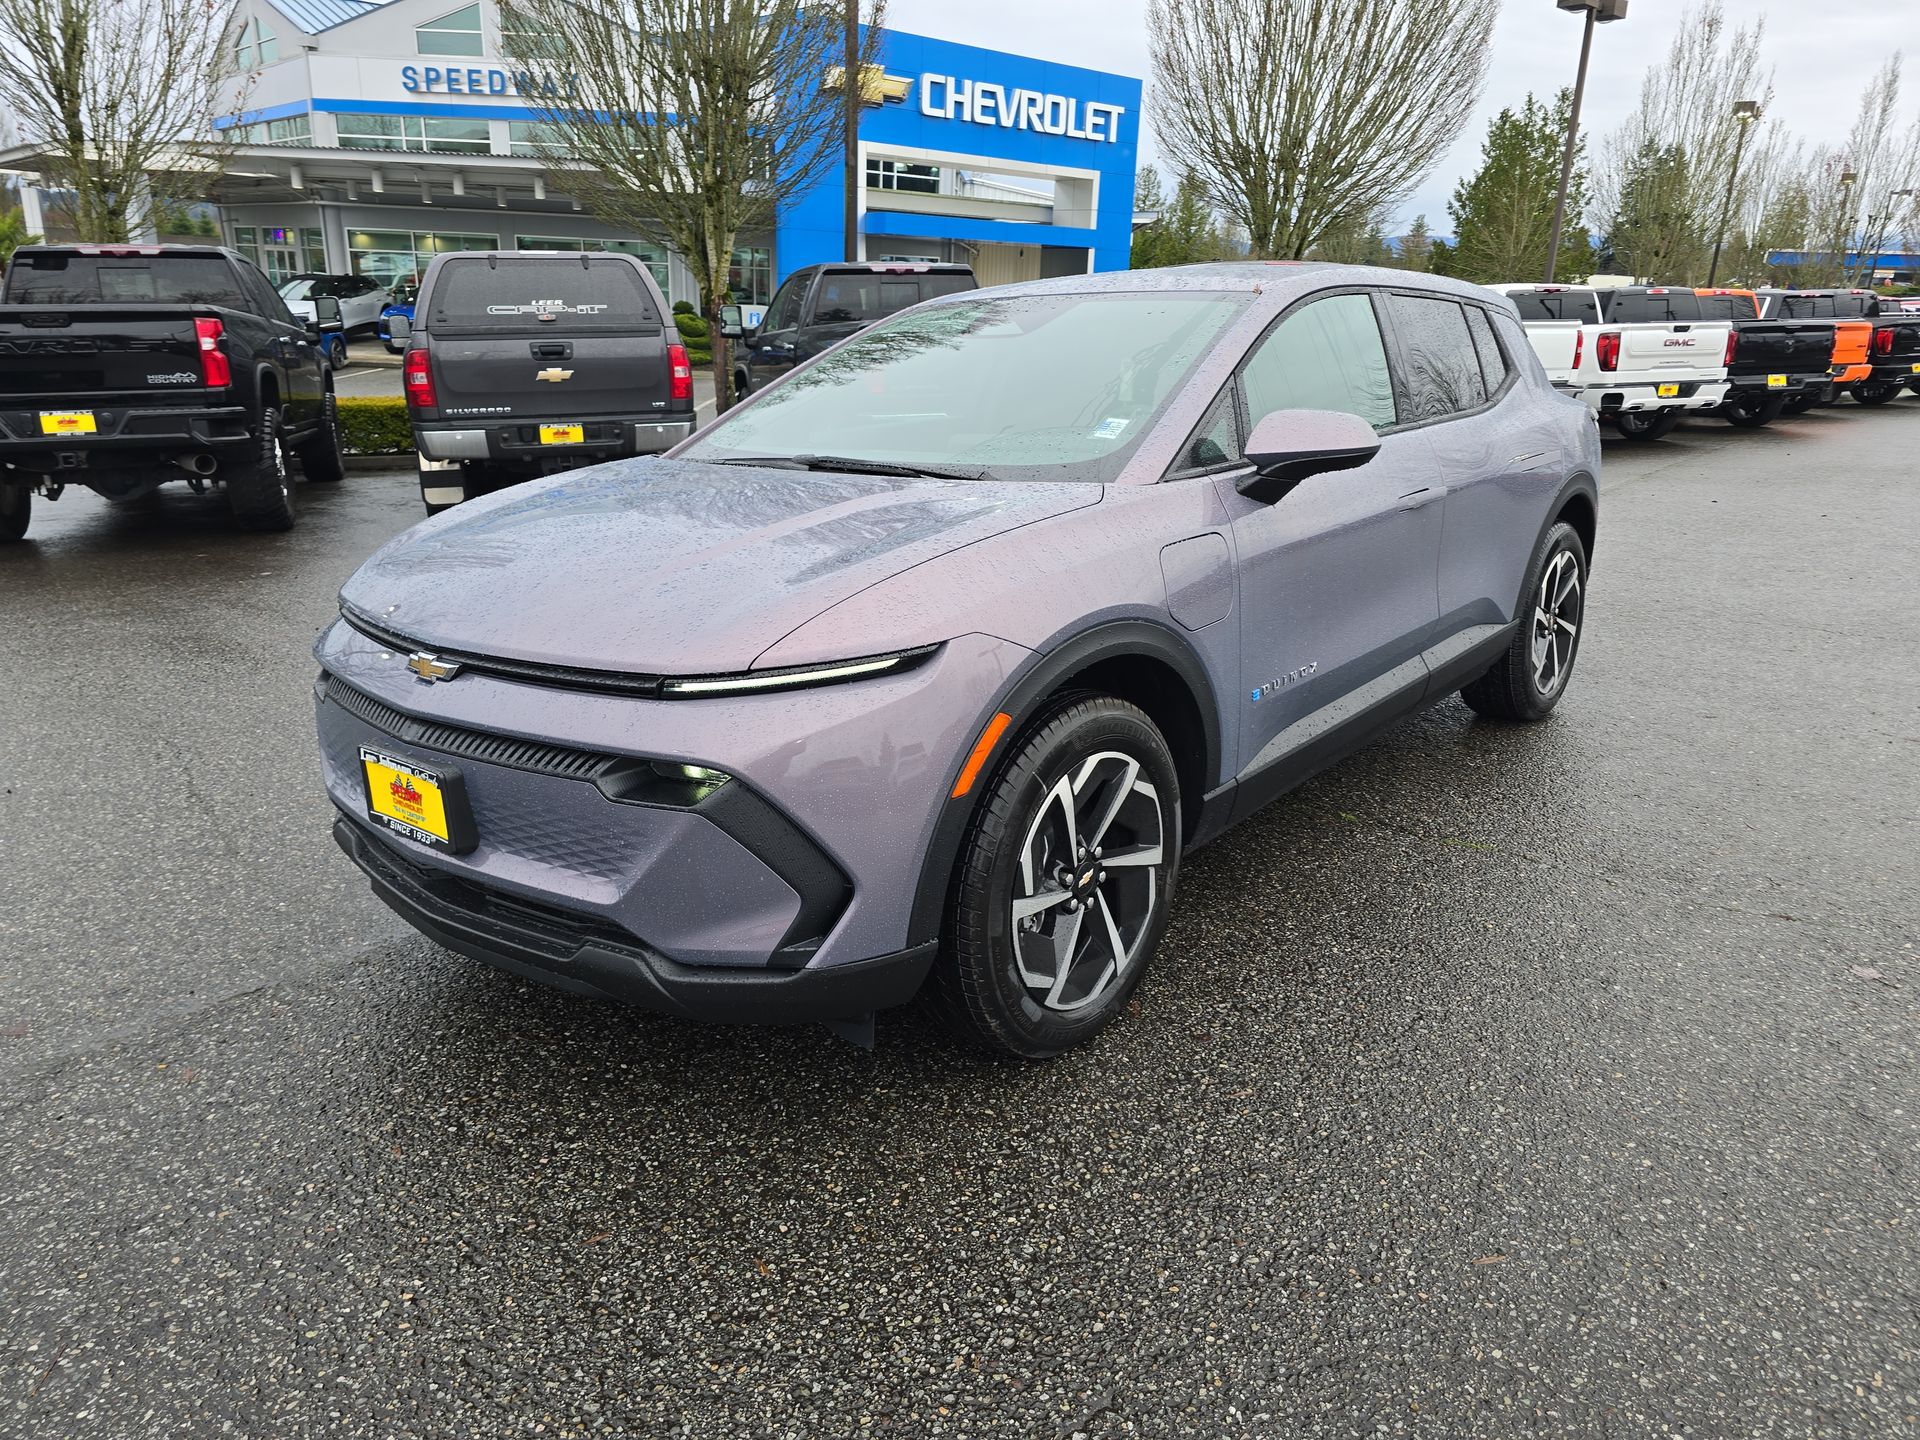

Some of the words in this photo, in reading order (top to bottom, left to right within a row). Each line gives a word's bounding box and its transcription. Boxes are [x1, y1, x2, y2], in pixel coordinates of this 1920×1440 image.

[920, 72, 1125, 143] CHEVROLET
[1663, 338, 1696, 347] GMC
[445, 406, 512, 415] SILVERADO
[1251, 661, 1318, 702] EQUINOX
[389, 820, 411, 837] SINCE
[413, 829, 431, 845] 1933
